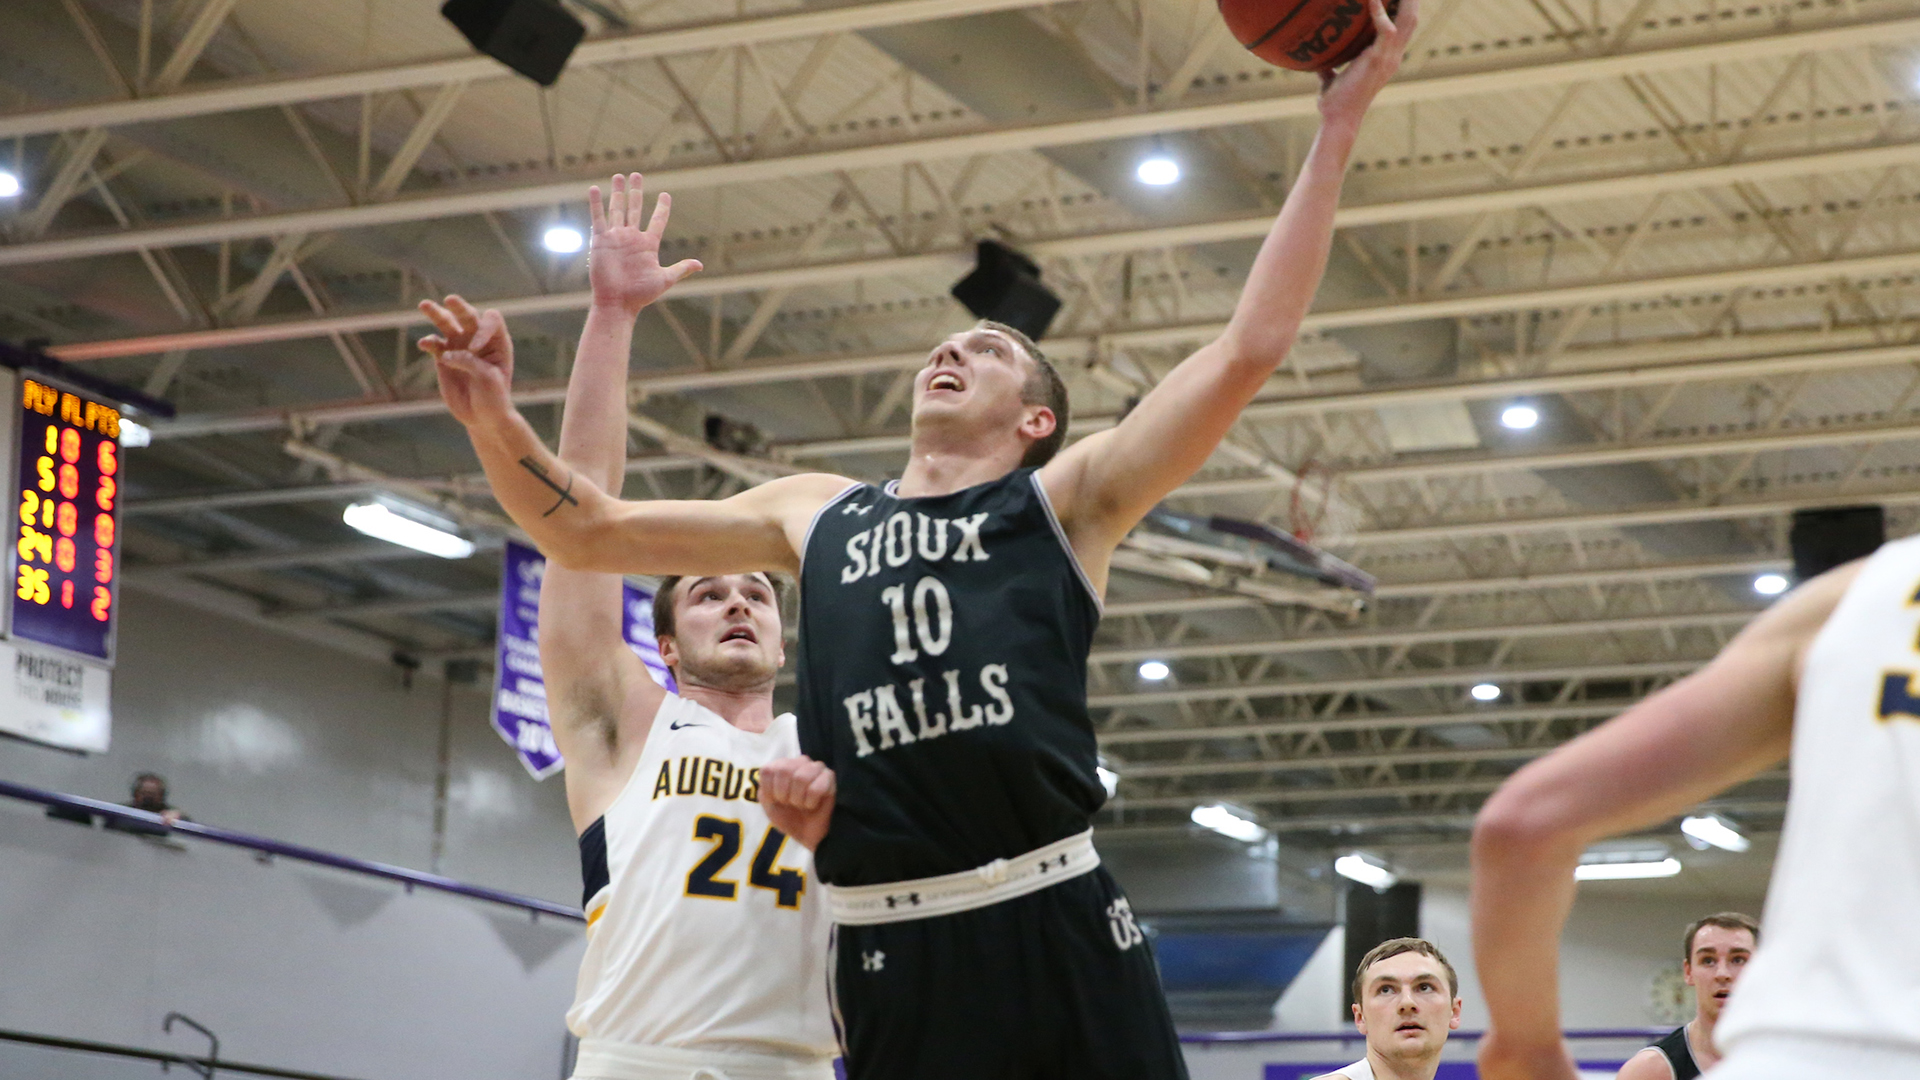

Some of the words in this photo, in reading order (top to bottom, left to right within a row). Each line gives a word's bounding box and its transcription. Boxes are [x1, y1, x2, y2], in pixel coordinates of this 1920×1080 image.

[46, 425, 58, 455] 1
[61, 393, 85, 427] FL
[85, 401, 120, 438] PTS
[19, 489, 55, 528] 21
[37, 456, 56, 492] 5
[96, 475, 117, 511] 2
[94, 548, 113, 584] 3
[841, 511, 990, 584] SIOUX
[17, 564, 51, 605] 35
[61, 580, 74, 609] 1
[91, 586, 112, 621] 2
[881, 576, 953, 665] 10
[843, 664, 1014, 758] FALLS
[684, 812, 807, 911] 24
